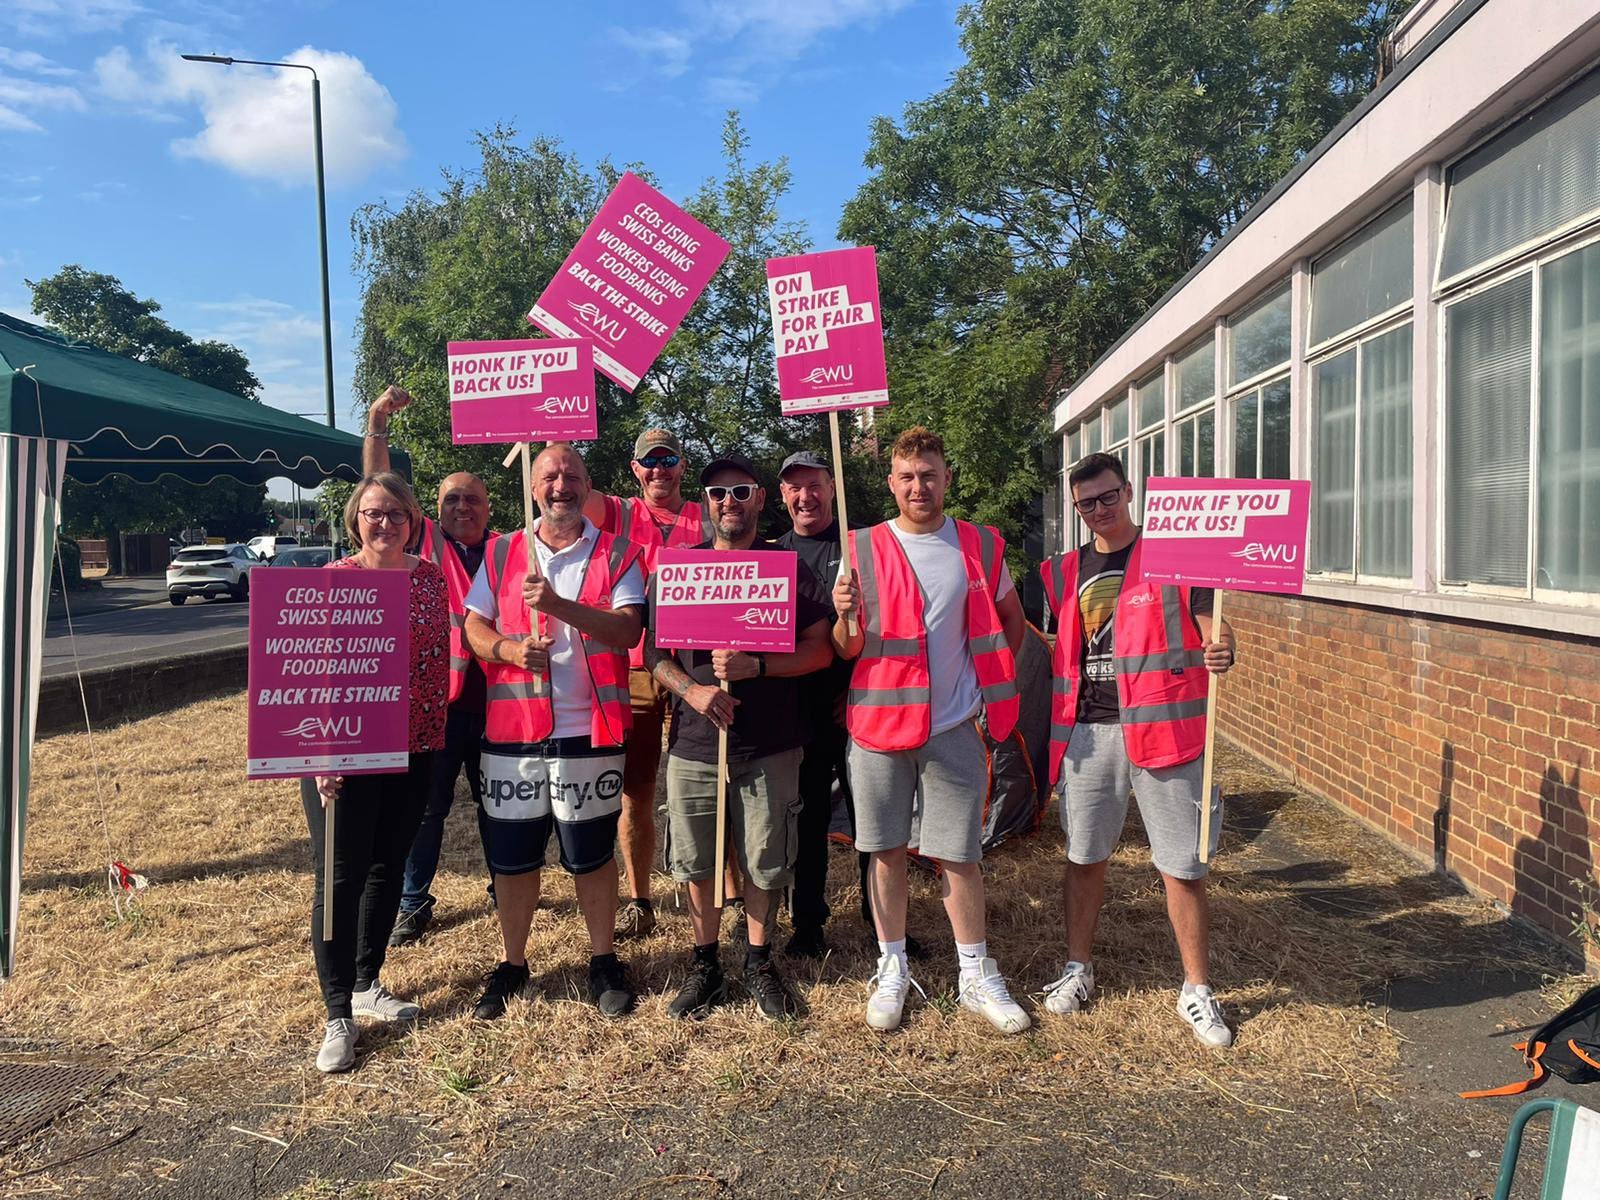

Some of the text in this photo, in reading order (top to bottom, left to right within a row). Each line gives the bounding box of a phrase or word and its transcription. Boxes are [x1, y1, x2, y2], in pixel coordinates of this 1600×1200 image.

[633, 202, 701, 255] CEOs USING
[618, 214, 695, 272] SWISS BANKS
[597, 228, 689, 299] WORKERS USING
[596, 251, 668, 306] FOODBANKS
[774, 276, 803, 296] ON
[567, 262, 603, 293] BACK
[600, 282, 628, 309] THE
[623, 301, 669, 338] STRIKE
[777, 290, 840, 315] STRIKE
[578, 302, 628, 342] CWU
[781, 306, 864, 335] FOR FAIR
[784, 334, 819, 354] PAY
[451, 351, 569, 376] HONK IF YOU
[453, 373, 535, 394] BACK US!
[808, 364, 853, 384] CWU
[542, 396, 589, 413] CWU
[1147, 494, 1280, 512] HONK IF YOU
[1146, 515, 1238, 532] BACK US!
[1242, 543, 1298, 563] CWU
[660, 565, 755, 582] ON STRIKE
[285, 588, 378, 604] CEOs USING
[661, 583, 785, 601] FOR FAIR PAY
[277, 608, 384, 625] SWISS BANKS
[744, 607, 789, 625] CWU
[265, 637, 396, 655] WORKERS USING
[281, 658, 380, 676] FOODBANKS
[257, 685, 402, 706] BACK THE STRIKE
[296, 716, 362, 738] CWU
